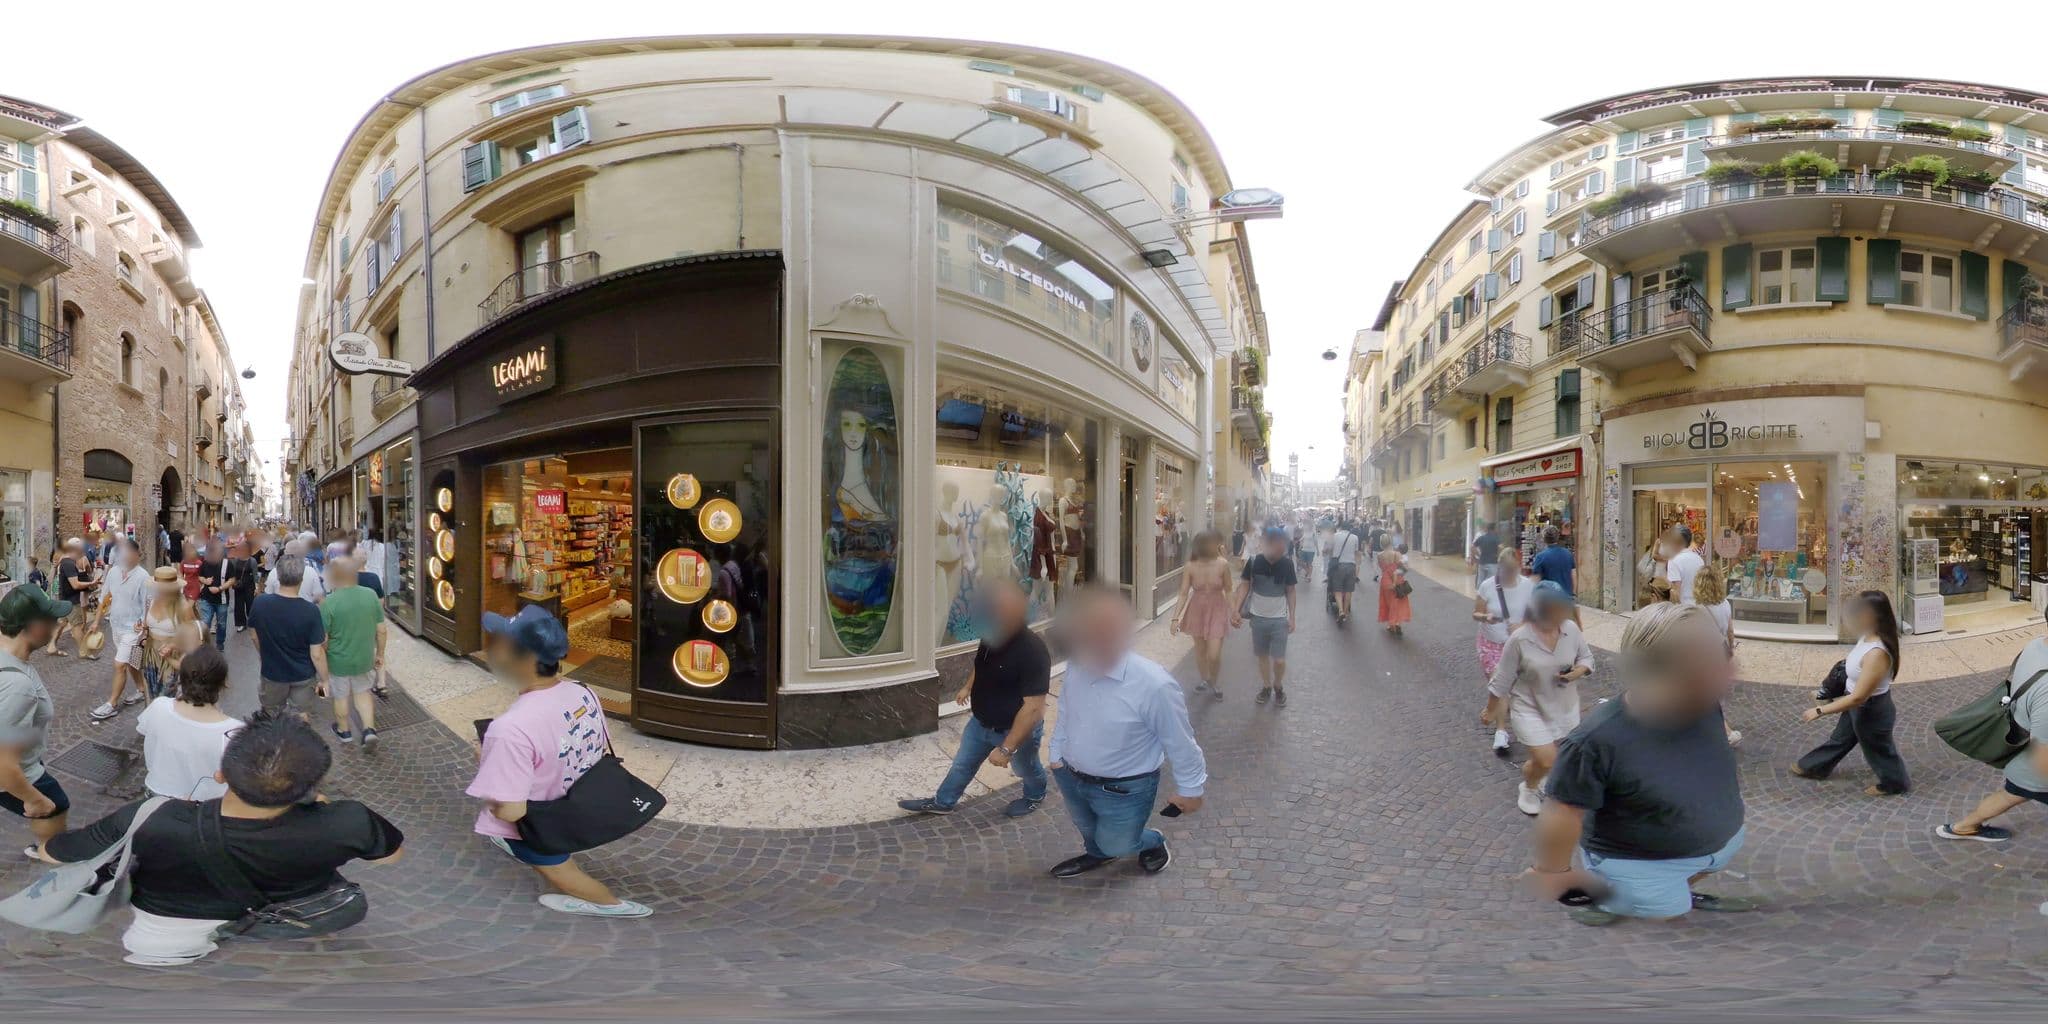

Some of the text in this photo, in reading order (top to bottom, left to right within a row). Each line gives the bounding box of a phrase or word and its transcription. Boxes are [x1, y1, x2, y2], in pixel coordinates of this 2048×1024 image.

[980, 252, 1087, 313] CALZEDONIA
[498, 375, 542, 396] MILANO
[1643, 431, 1686, 450] BIJOU
